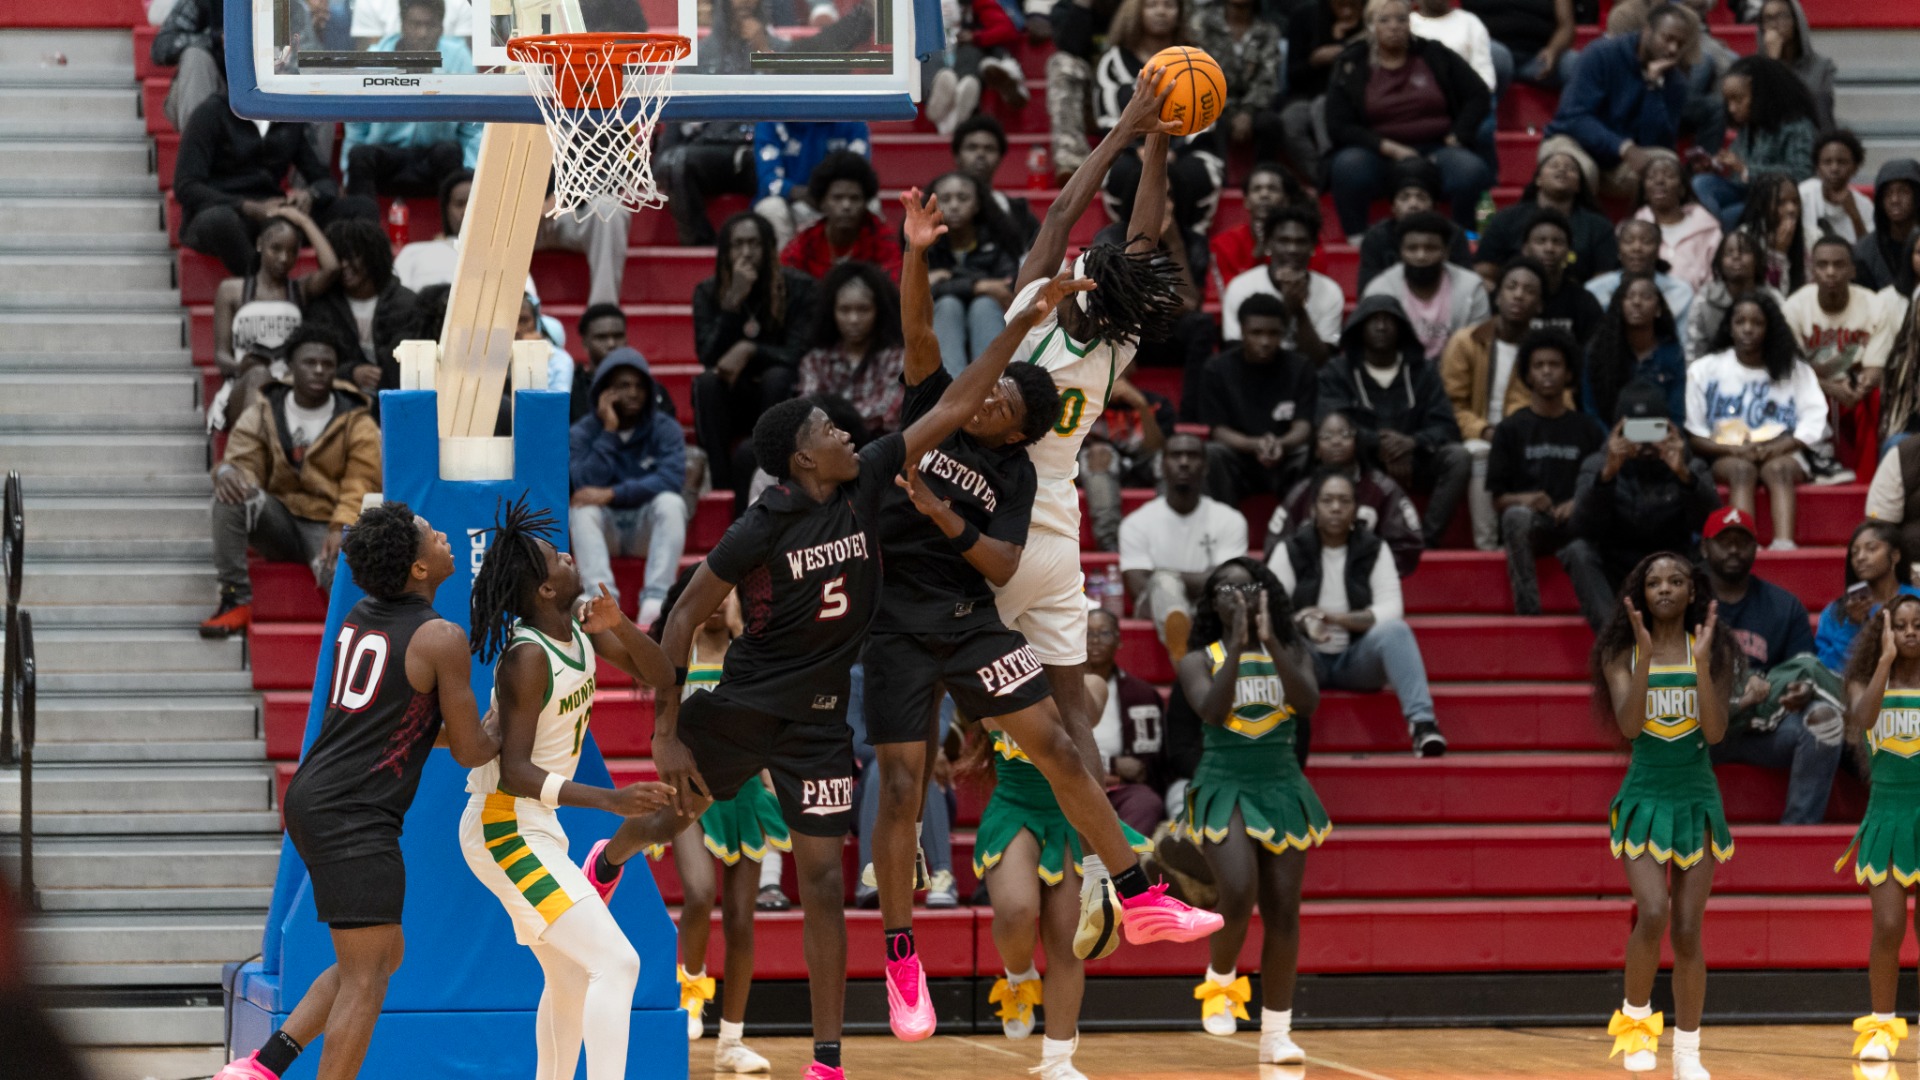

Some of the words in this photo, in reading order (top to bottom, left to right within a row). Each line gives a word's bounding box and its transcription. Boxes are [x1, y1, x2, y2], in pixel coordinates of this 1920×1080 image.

[1052, 385, 1089, 438] 0
[816, 573, 851, 621] 5
[329, 622, 391, 713] 10
[558, 673, 597, 716] MONR
[1645, 688, 1700, 721] ONRO
